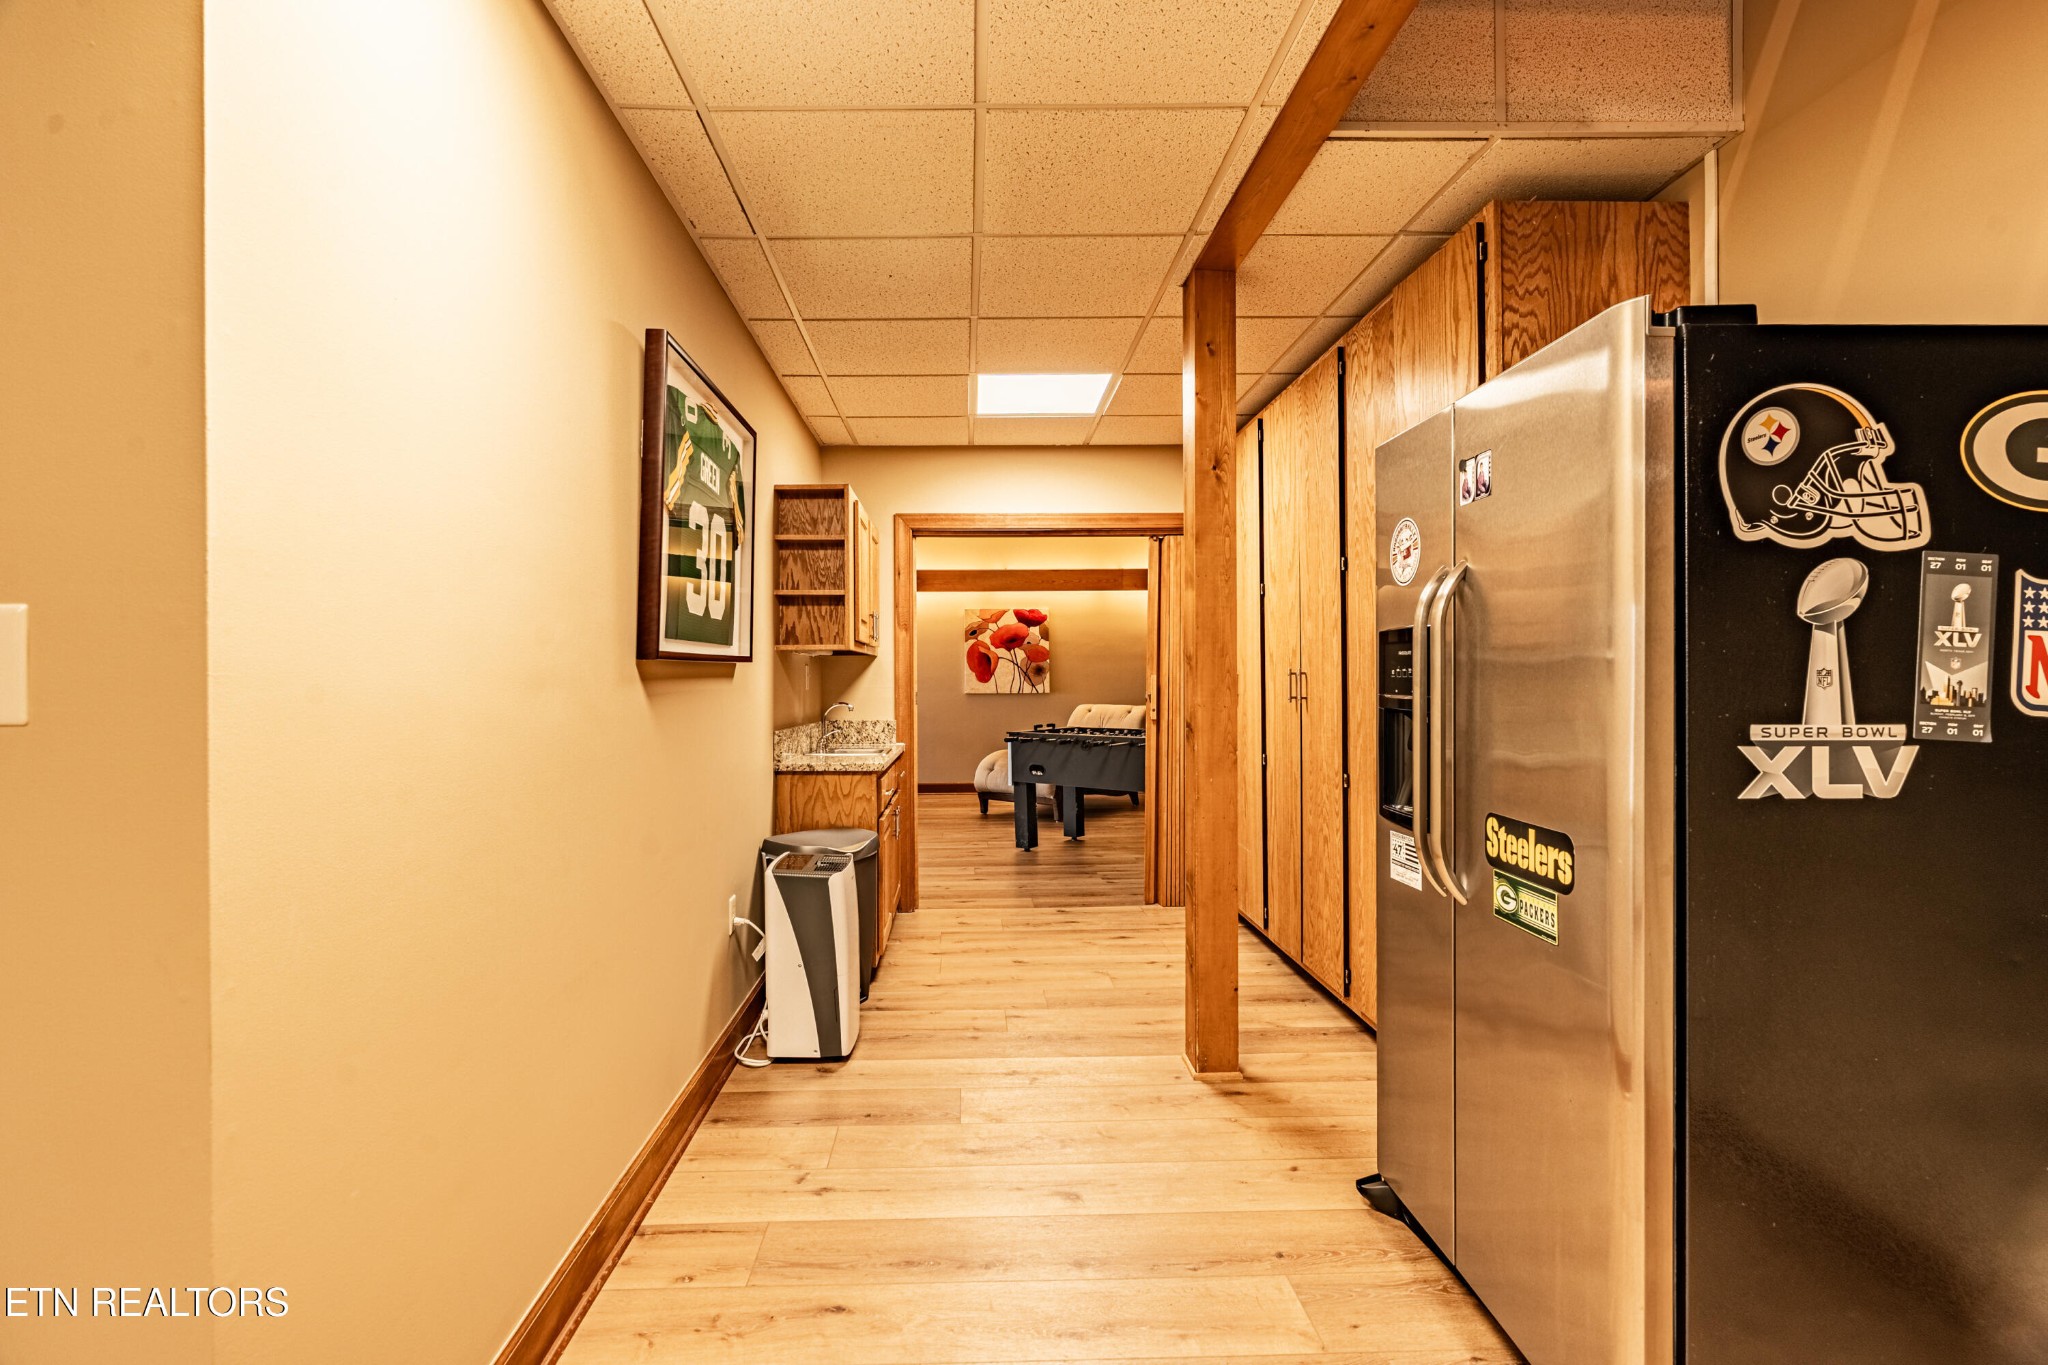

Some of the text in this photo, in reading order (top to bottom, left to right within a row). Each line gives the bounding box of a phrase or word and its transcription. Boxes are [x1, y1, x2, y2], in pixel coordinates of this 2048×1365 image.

[1747, 433, 1767, 444] Steelers
[700, 451, 720, 496] GREEN
[686, 500, 727, 620] 30
[1929, 561, 1942, 569] 27
[1980, 564, 1992, 572] 01
[1933, 630, 1983, 648] XLV
[1817, 676, 1831, 687] NFL
[1761, 726, 1898, 738] SUPER BOWL
[1921, 726, 1933, 734] 27
[1972, 729, 1984, 737] 01
[1737, 745, 1920, 799] XLV
[1393, 843, 1403, 856] 47
[1486, 816, 1573, 886] Steelers
[1519, 899, 1556, 928] PACKERS
